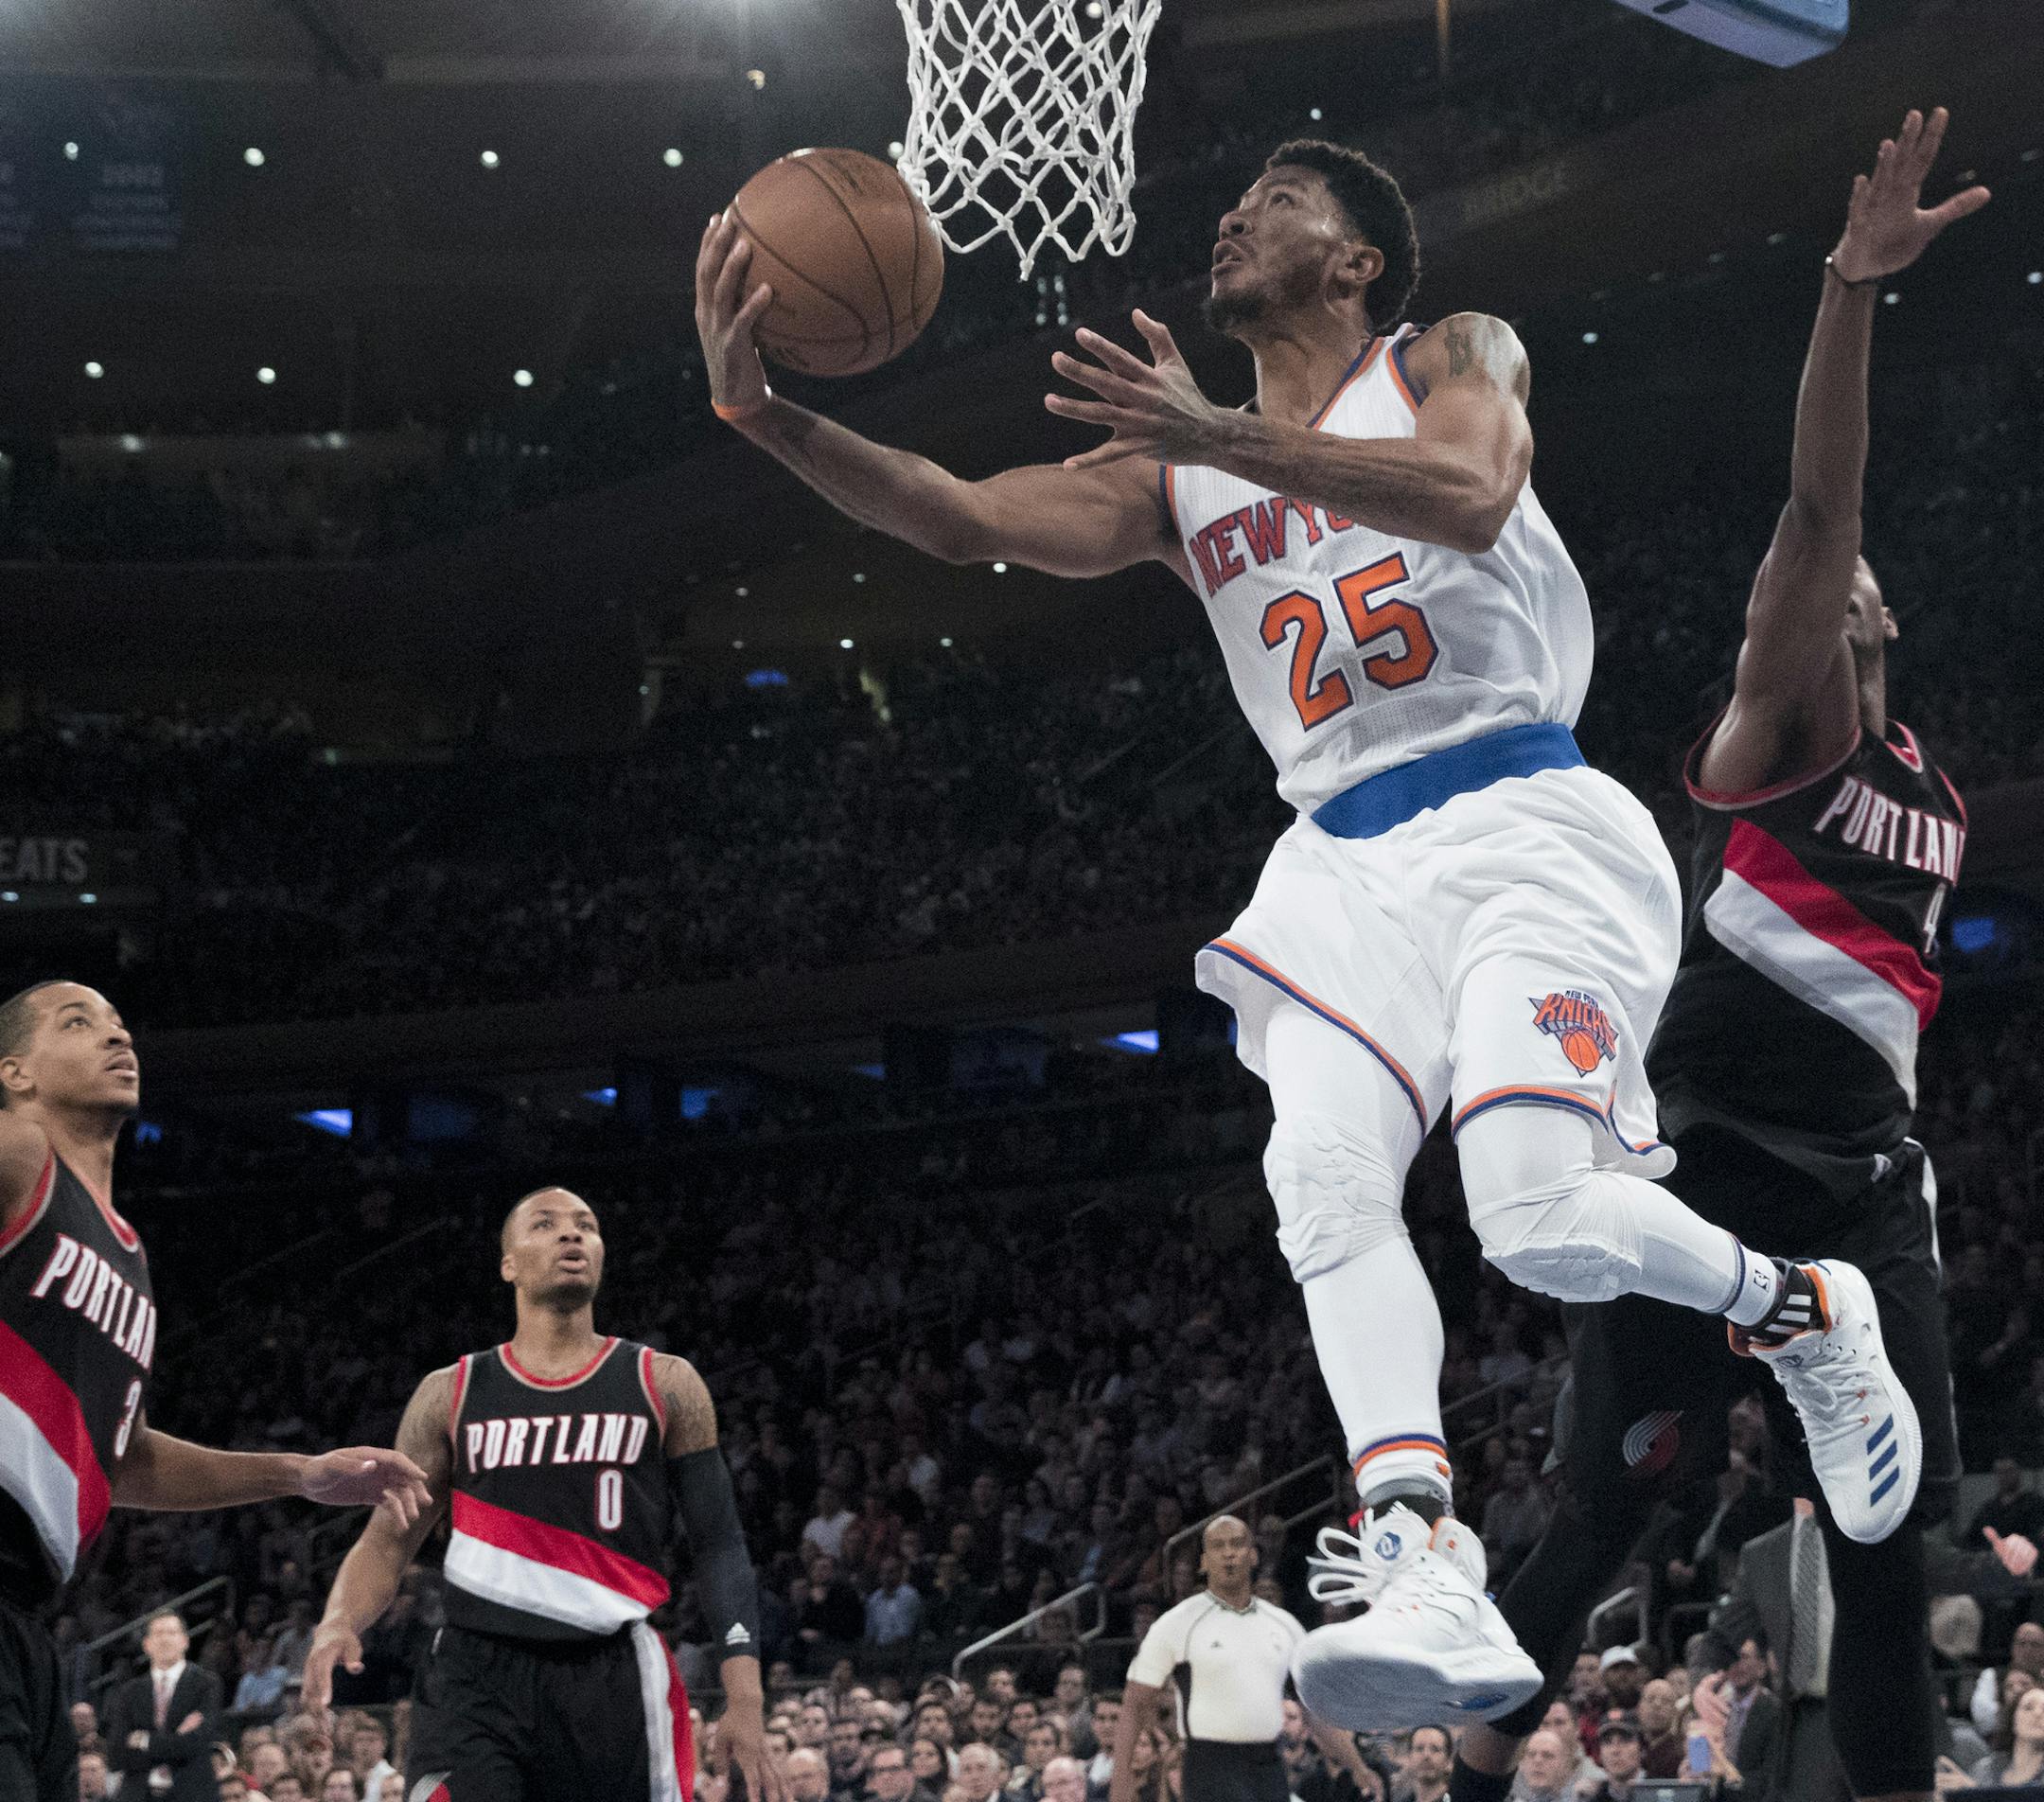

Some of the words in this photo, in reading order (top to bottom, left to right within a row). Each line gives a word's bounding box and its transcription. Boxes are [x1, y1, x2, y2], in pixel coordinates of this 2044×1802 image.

[1189, 495, 1288, 599] NEW
[1260, 551, 1439, 732] 25
[1922, 881, 1947, 956] 4
[29, 1232, 157, 1370] PORTLAN
[114, 1378, 143, 1460] 3
[465, 1413, 650, 1475] PORTLAND
[596, 1467, 624, 1532] 0
